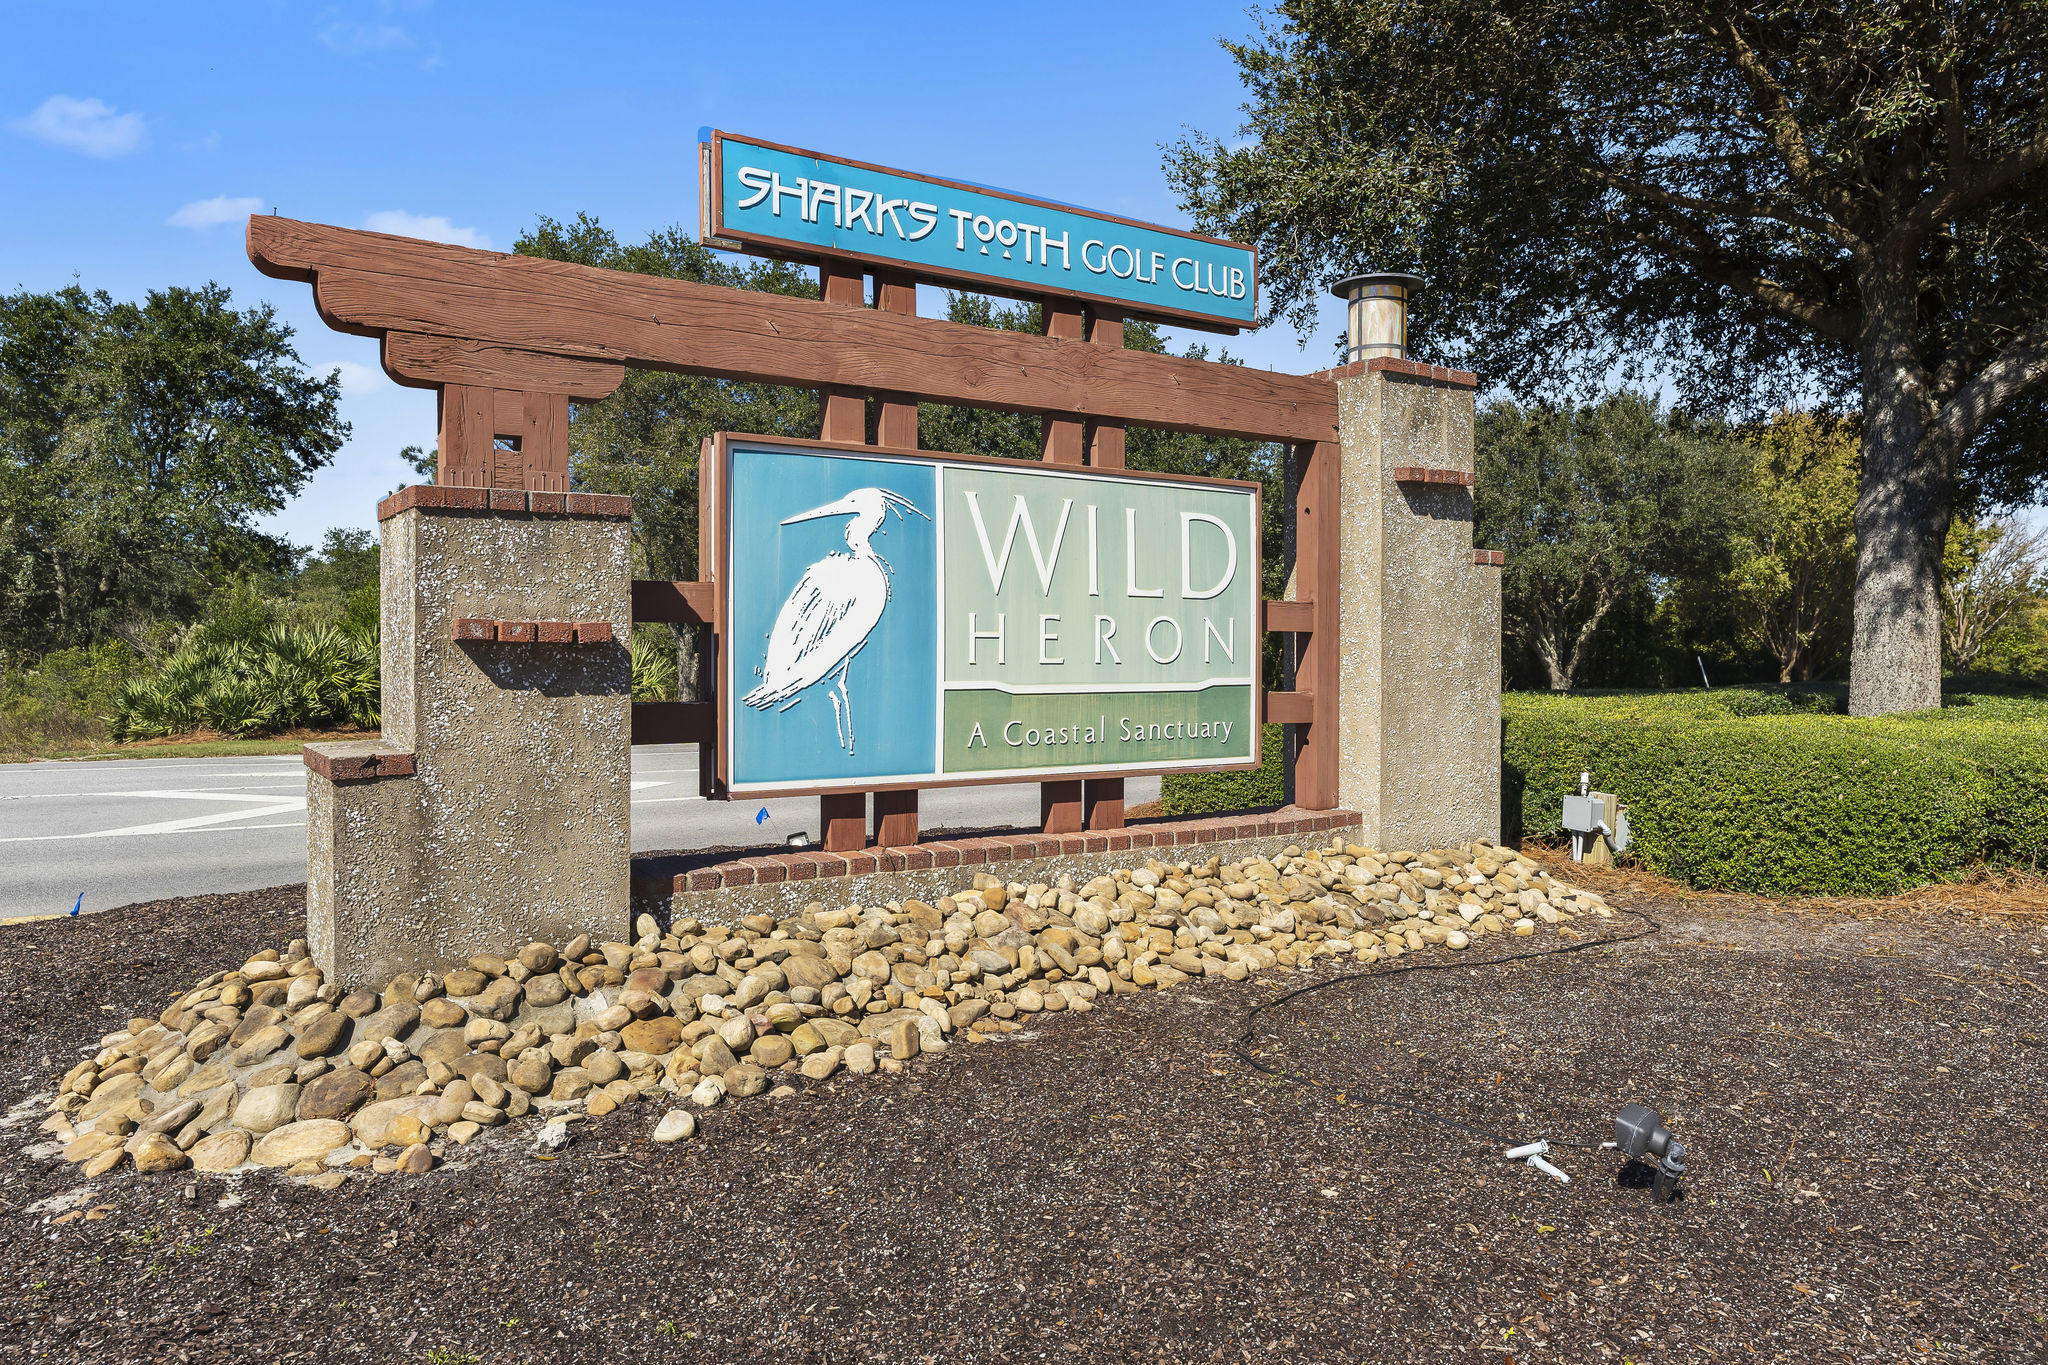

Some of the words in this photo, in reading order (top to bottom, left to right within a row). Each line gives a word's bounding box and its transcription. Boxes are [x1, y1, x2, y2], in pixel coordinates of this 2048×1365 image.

[738, 166, 938, 241] SHARK'S
[949, 208, 1070, 269] TOOTH
[1081, 239, 1165, 285] GOLF
[1172, 257, 1247, 299] CLUB
[964, 491, 1238, 599] WILD
[967, 612, 1235, 665] HERON
[967, 721, 988, 748] A
[1003, 715, 1106, 747] Coastal
[1119, 717, 1234, 744] Sanctuary
